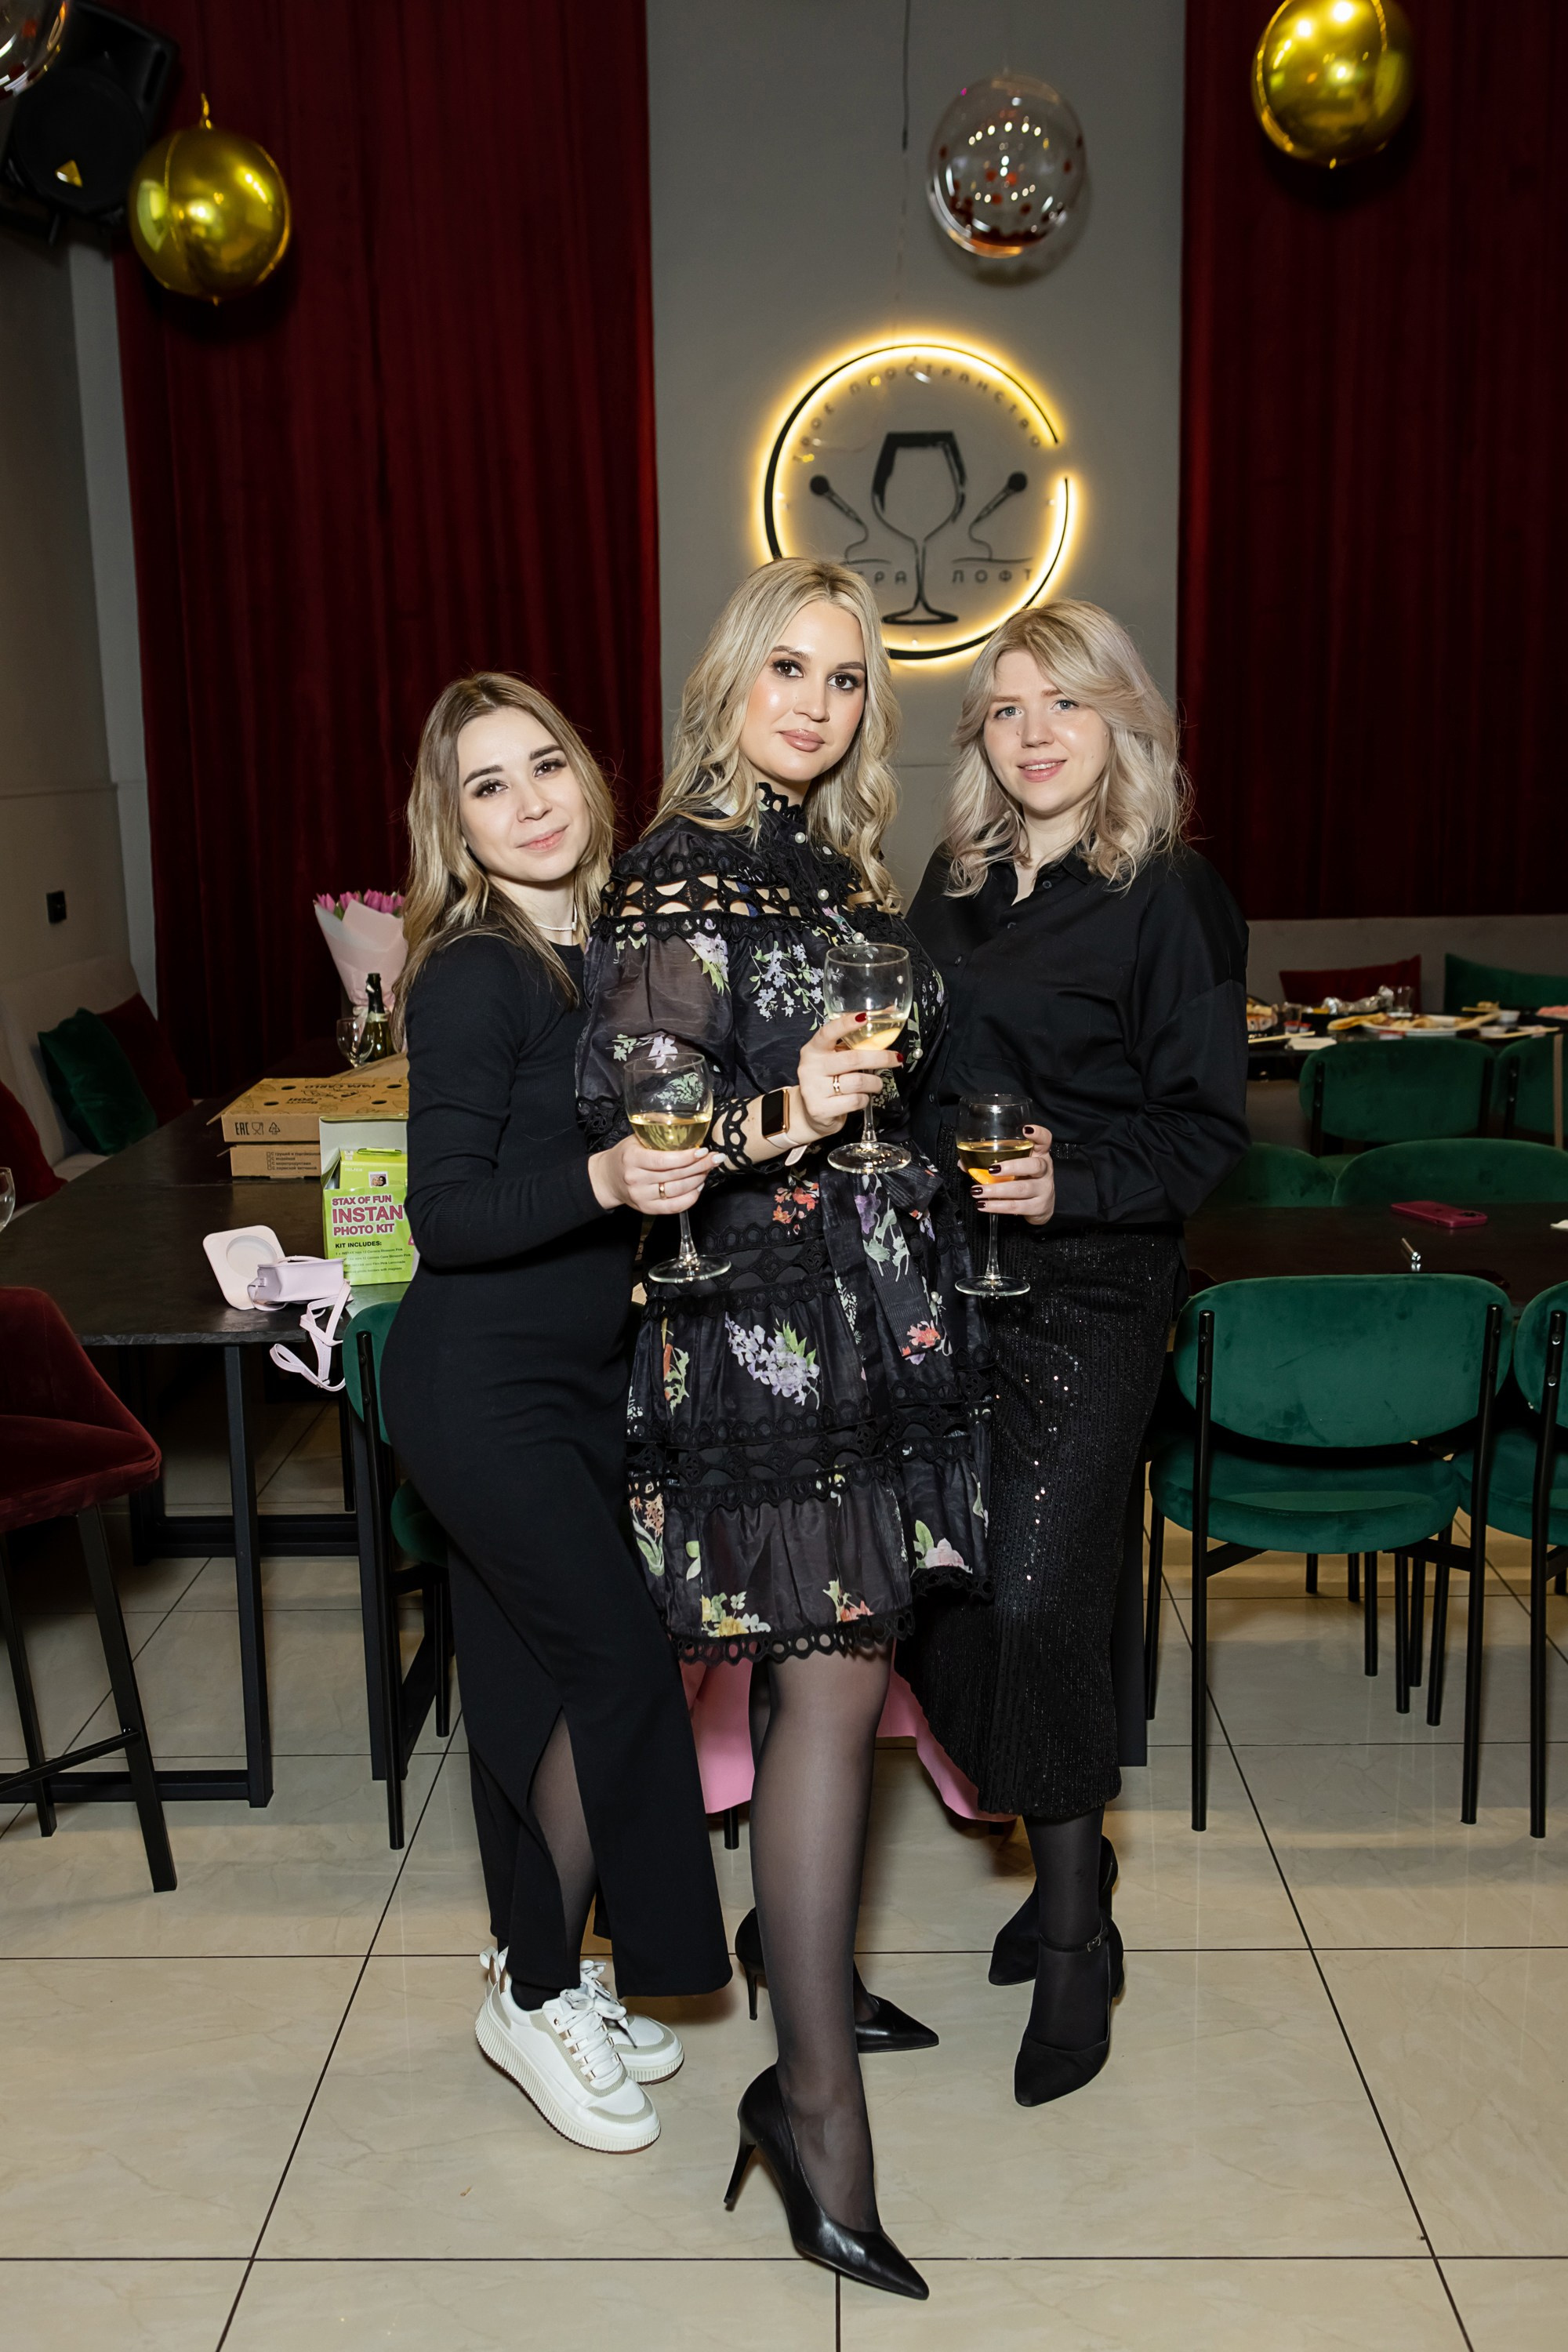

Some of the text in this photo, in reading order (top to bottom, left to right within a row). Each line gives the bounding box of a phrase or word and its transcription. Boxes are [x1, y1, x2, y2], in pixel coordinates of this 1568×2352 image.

[953, 568, 1033, 583] ЛОФТ
[332, 1197, 356, 1206] STAX
[372, 1195, 391, 1203] FUN
[332, 1205, 405, 1223] INSTAN
[333, 1224, 394, 1236] PHOTO KIT
